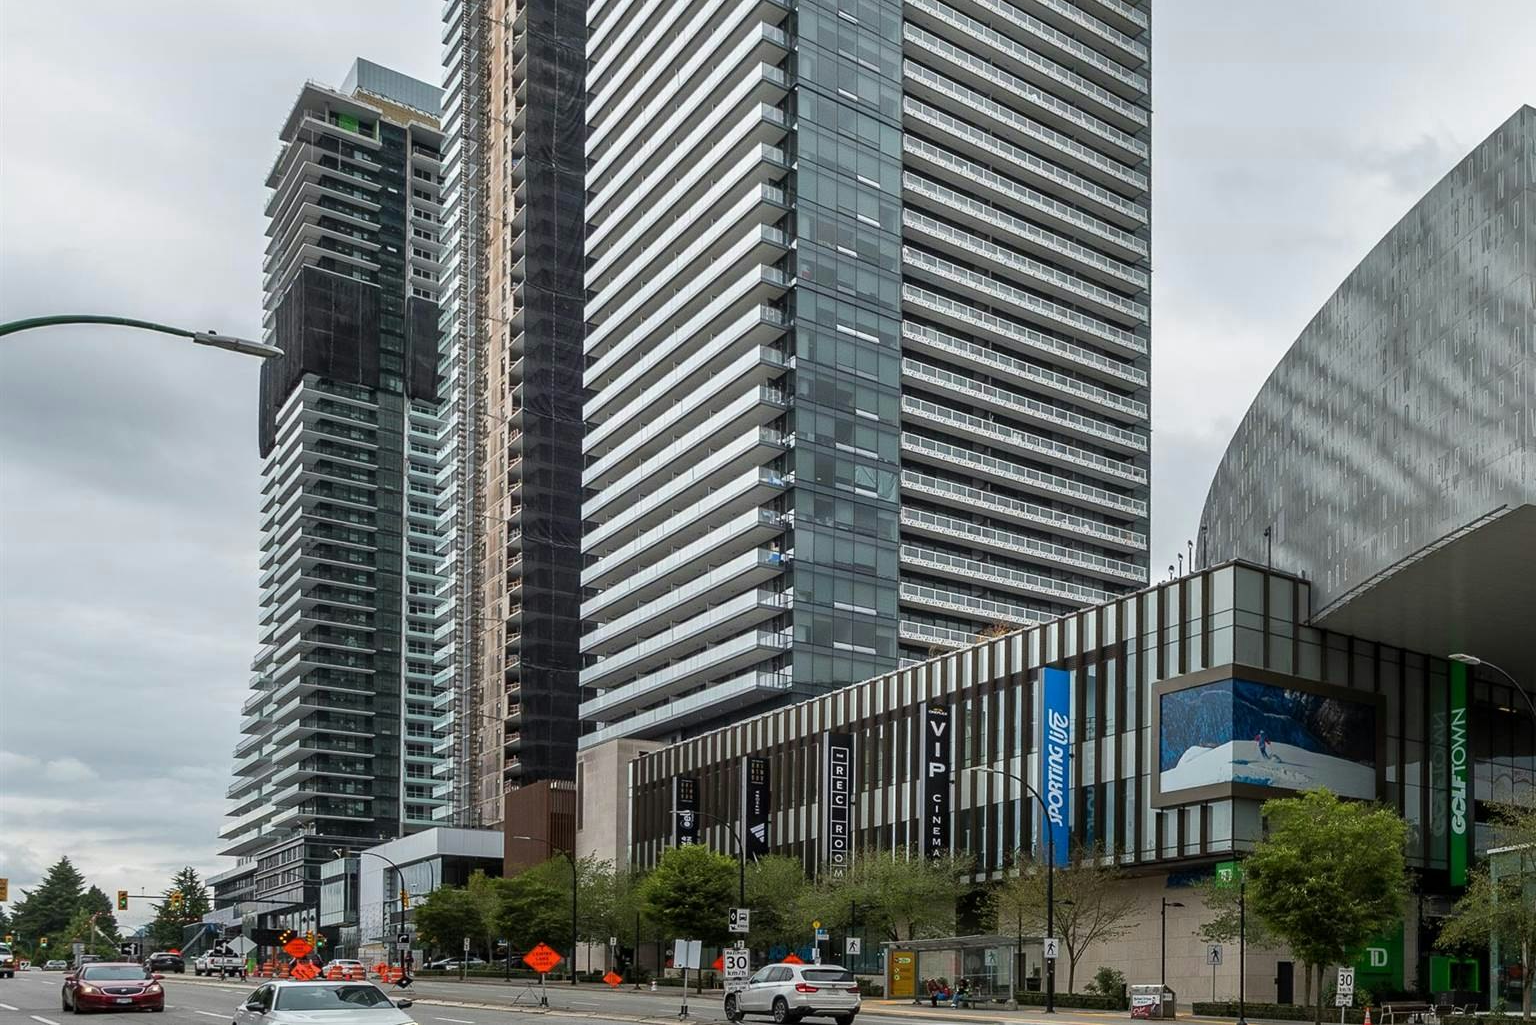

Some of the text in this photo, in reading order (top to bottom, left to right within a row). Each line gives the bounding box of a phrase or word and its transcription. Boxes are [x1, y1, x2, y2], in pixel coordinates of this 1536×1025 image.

[928, 720, 947, 777] VIP
[726, 956, 747, 969] 30
[1366, 947, 1388, 967] TD
[1339, 974, 1353, 986] 30
